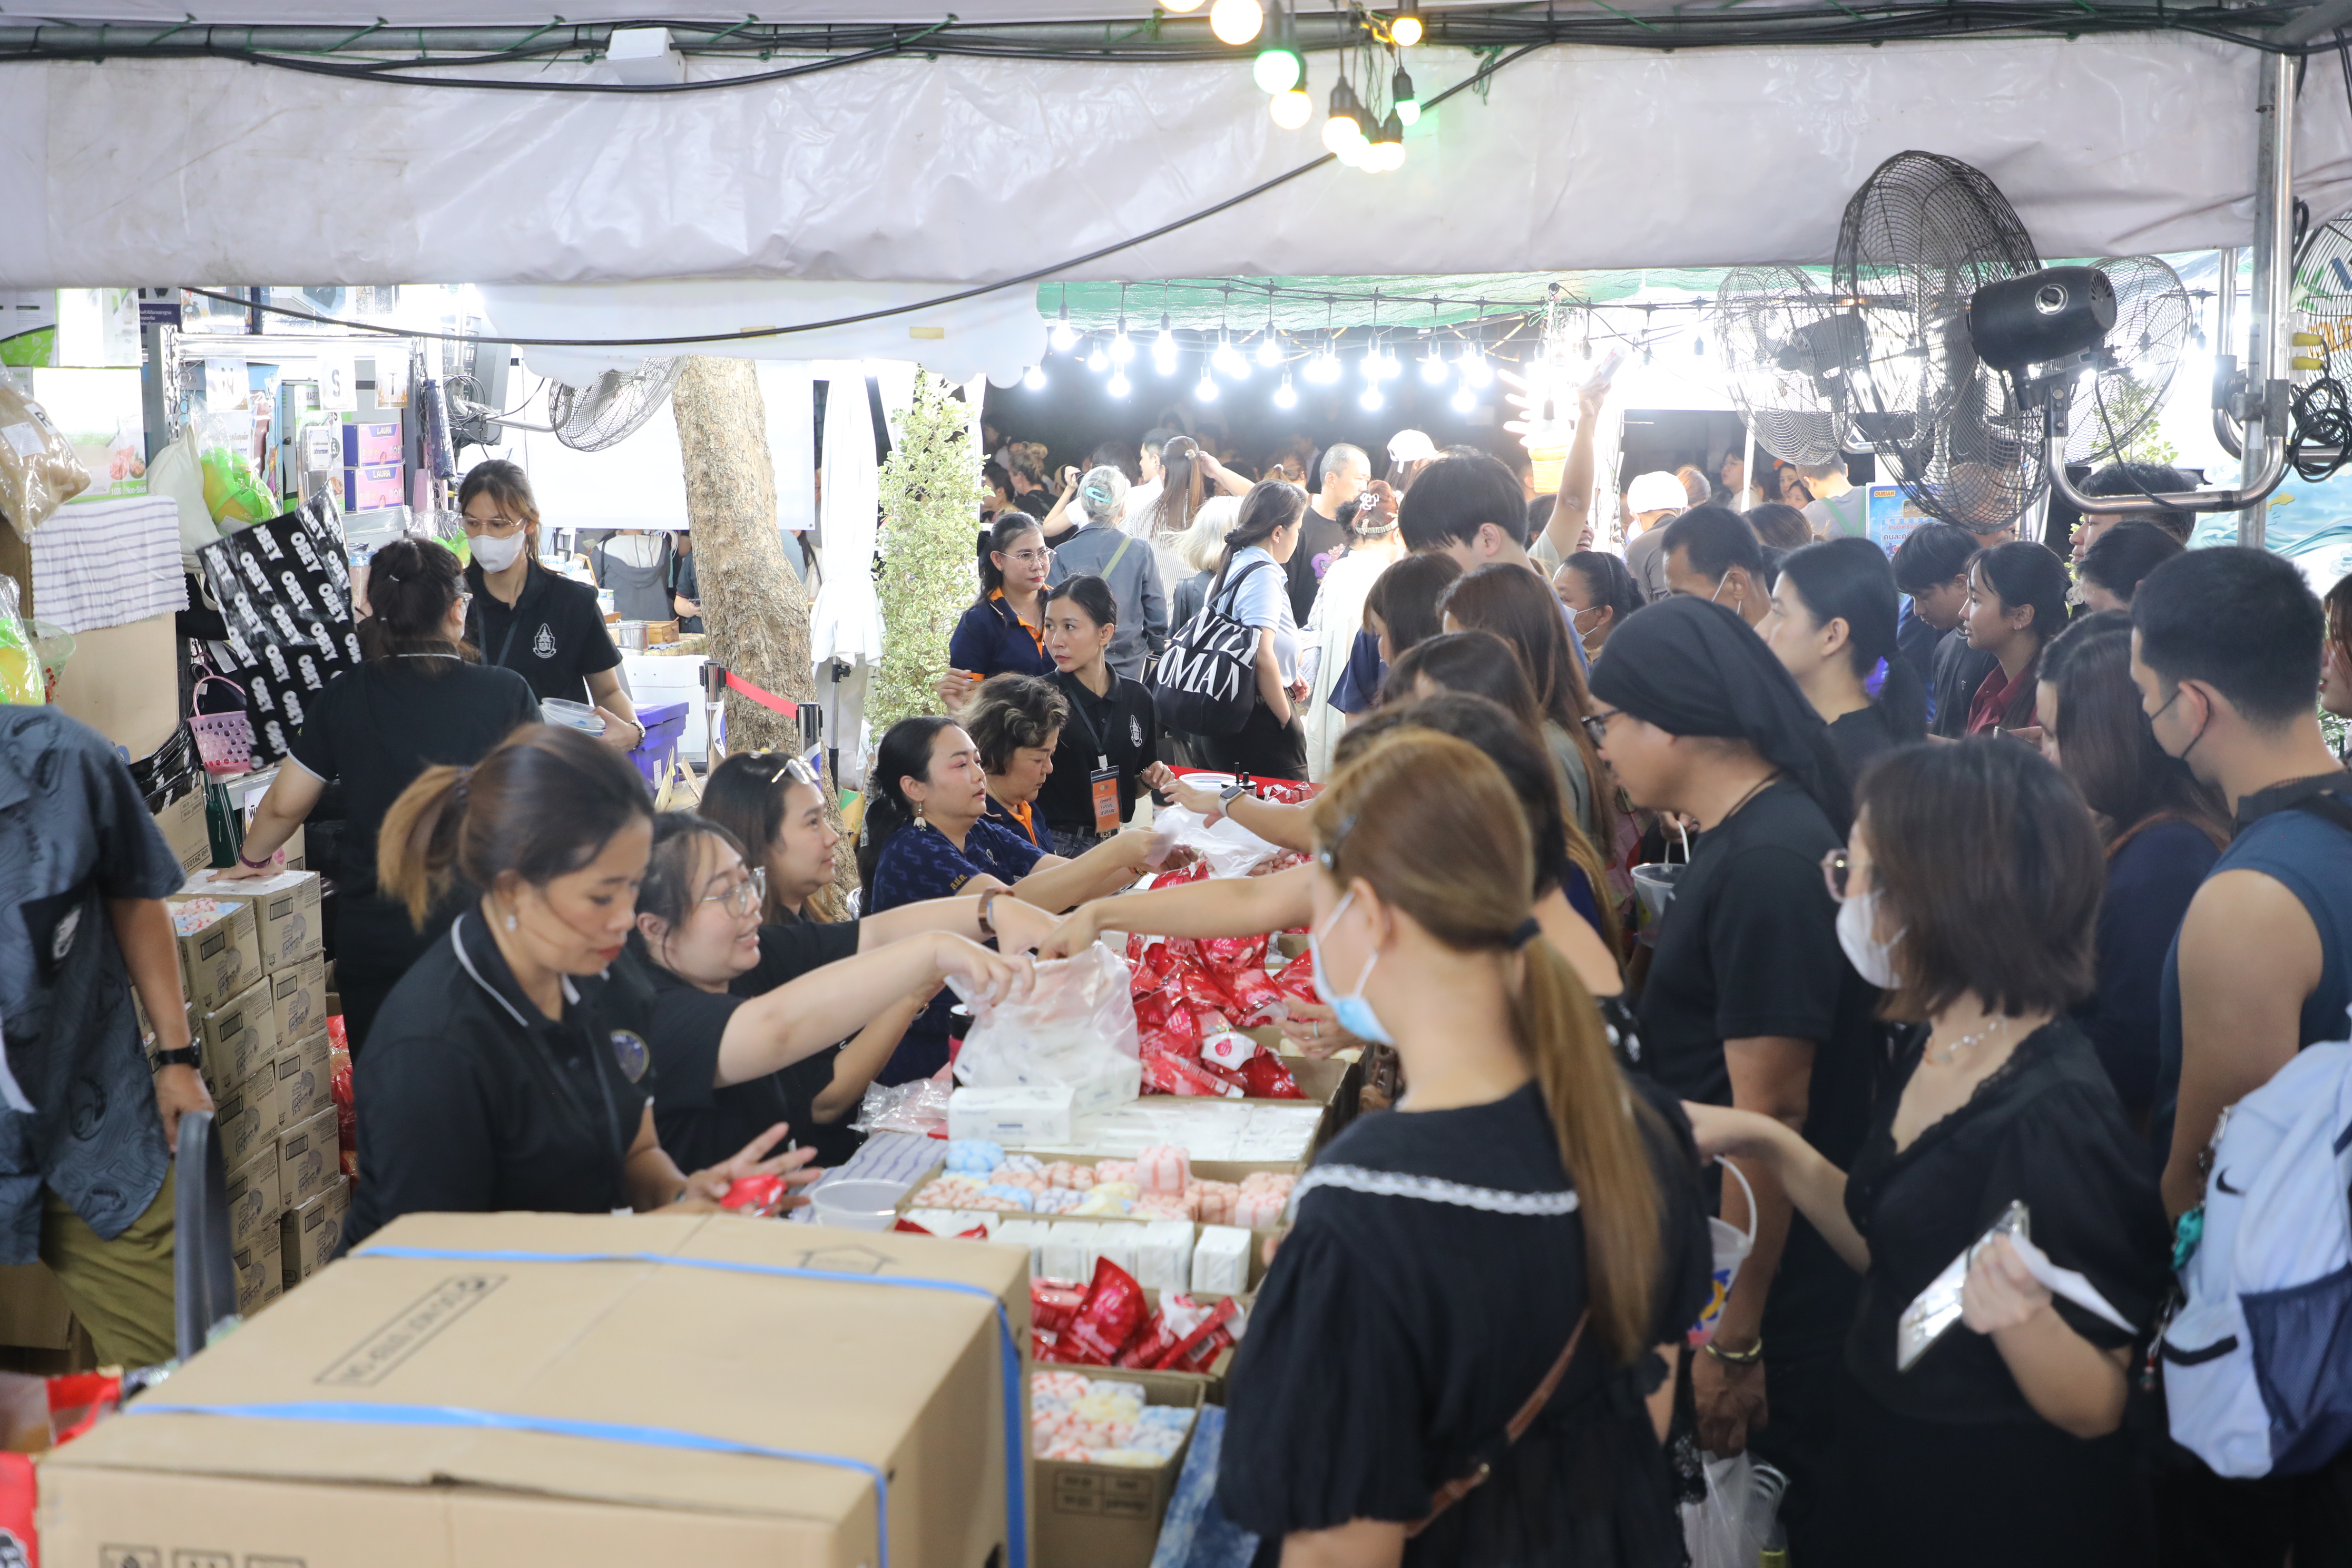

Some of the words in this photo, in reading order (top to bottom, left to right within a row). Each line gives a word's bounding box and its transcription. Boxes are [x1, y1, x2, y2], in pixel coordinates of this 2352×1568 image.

[331, 369, 340, 397] S
[34, 411, 52, 428] R
[377, 426, 392, 435] LAURA
[373, 469, 391, 479] LAURA
[290, 532, 323, 573] OBEY
[327, 550, 351, 591] OBEY
[240, 551, 273, 595] OBEY
[281, 571, 313, 613] OBEY
[234, 592, 267, 635] OBEY
[318, 583, 349, 624] OBEY
[270, 604, 304, 646] OBEY
[310, 622, 339, 662] OBEY
[228, 625, 259, 669] OBEY
[264, 644, 291, 683] OBEY
[298, 654, 323, 691] OBEY
[183, 854, 200, 870] 291013
